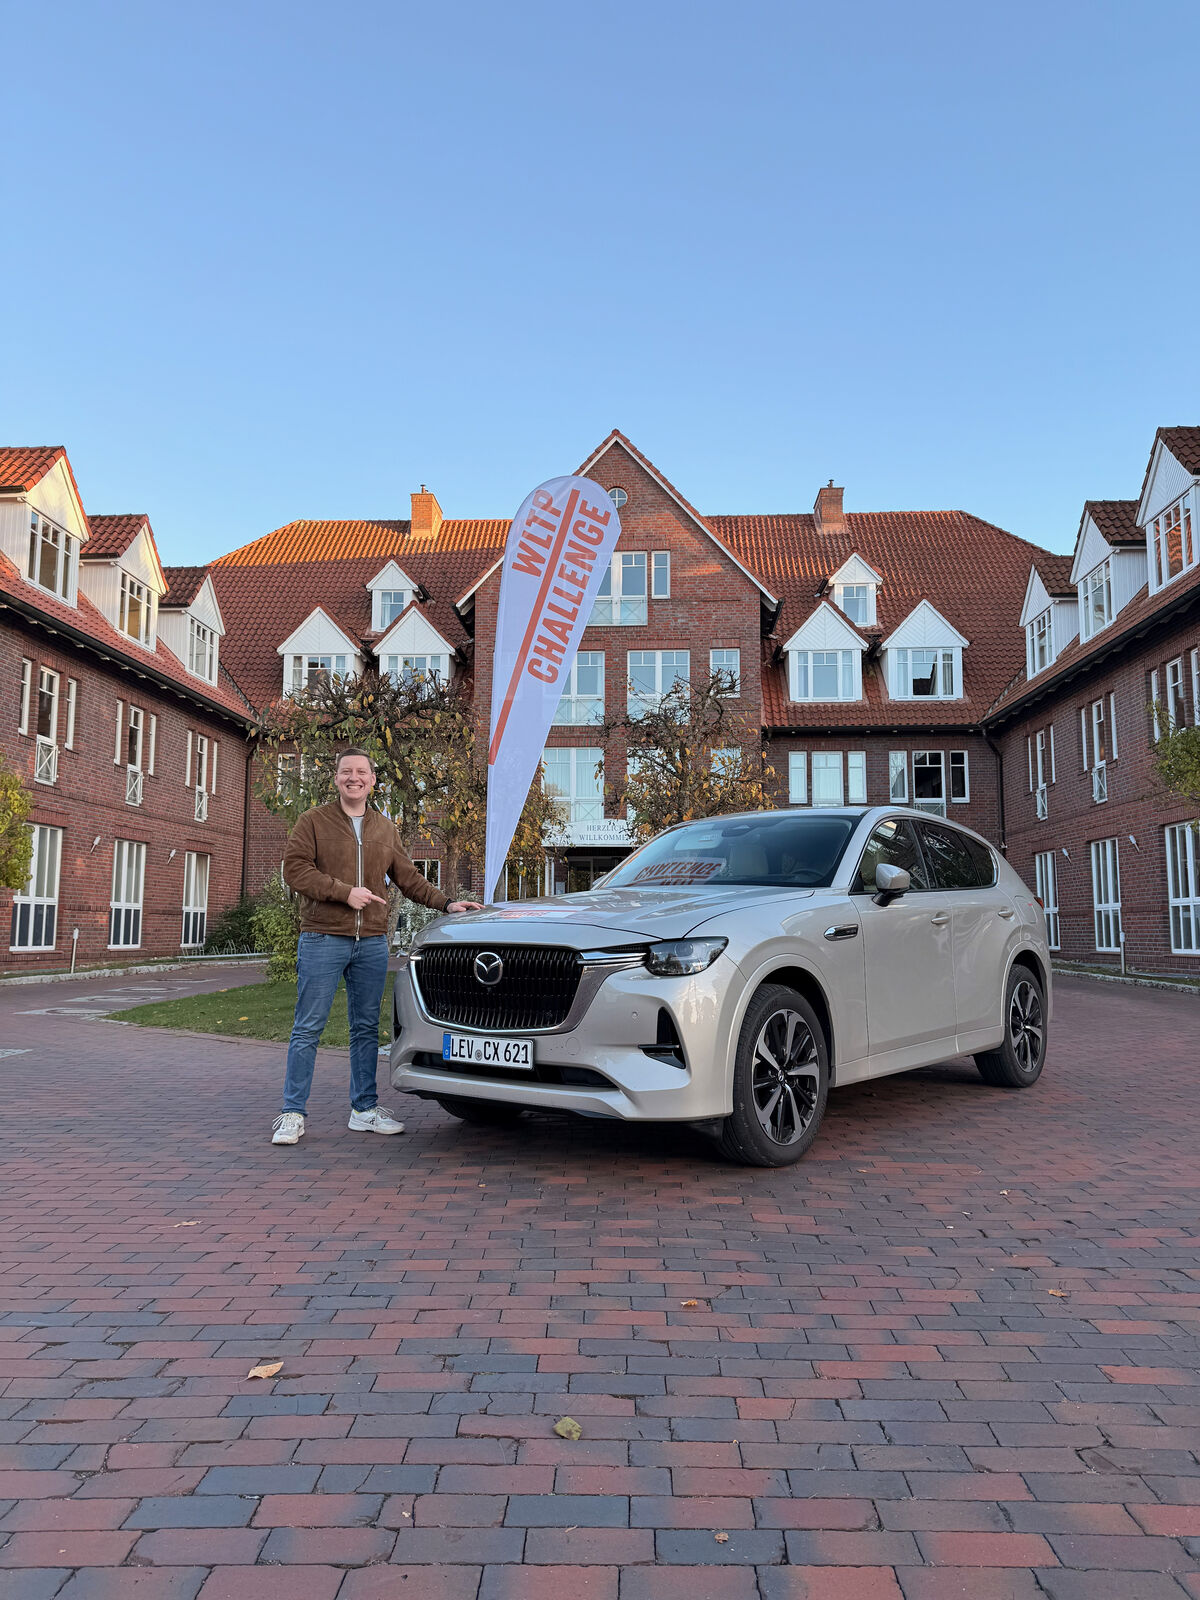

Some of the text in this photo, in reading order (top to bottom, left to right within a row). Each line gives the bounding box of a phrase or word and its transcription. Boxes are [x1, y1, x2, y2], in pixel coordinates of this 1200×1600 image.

[511, 489, 561, 577] WLTP
[527, 499, 611, 684] CHALLENGE
[451, 1038, 530, 1064] LEV CX 621
